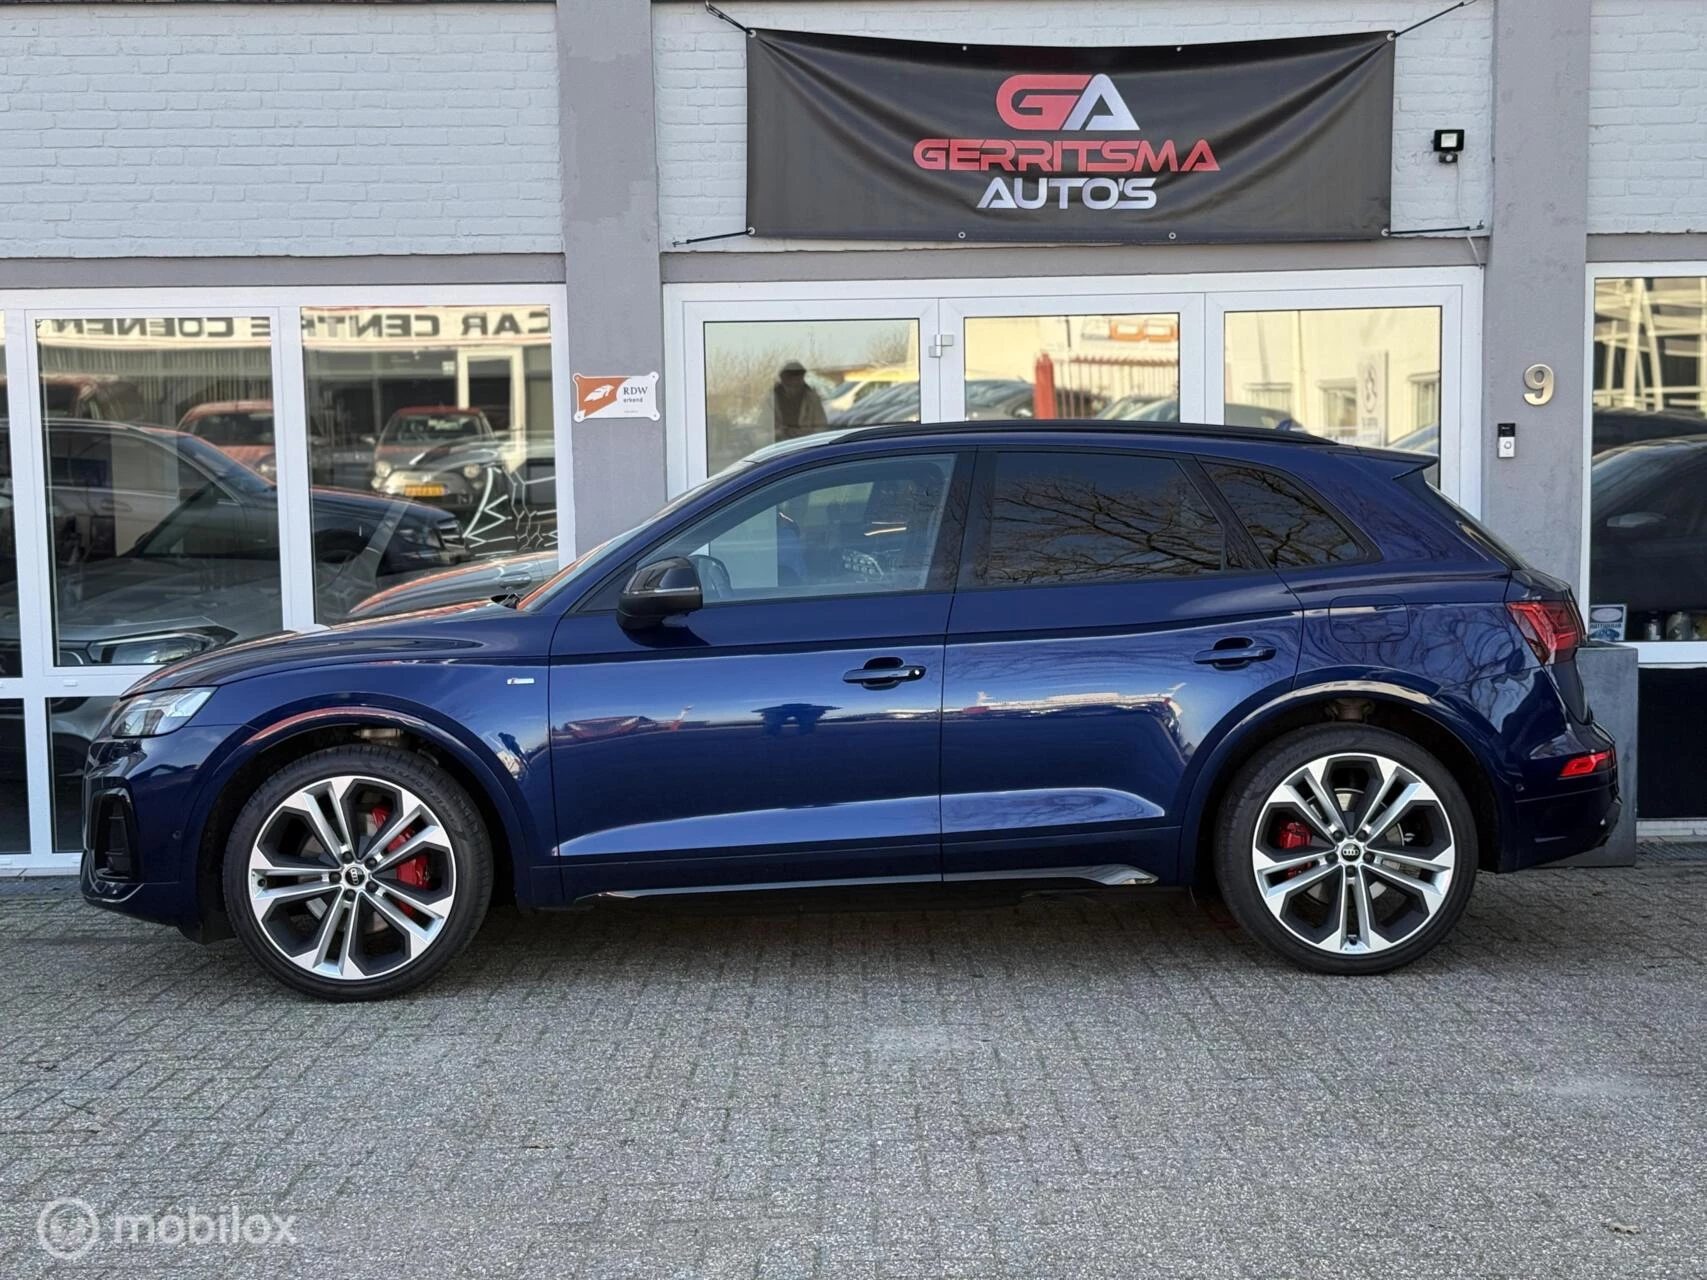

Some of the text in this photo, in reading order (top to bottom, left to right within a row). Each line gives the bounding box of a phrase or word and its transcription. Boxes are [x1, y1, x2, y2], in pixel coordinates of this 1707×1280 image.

[996, 73, 1140, 131] GA
[913, 138, 1220, 172] GERRITSMA
[976, 177, 1157, 210] AUTO'S
[623, 386, 648, 395] RDW
[1523, 363, 1554, 406] 9
